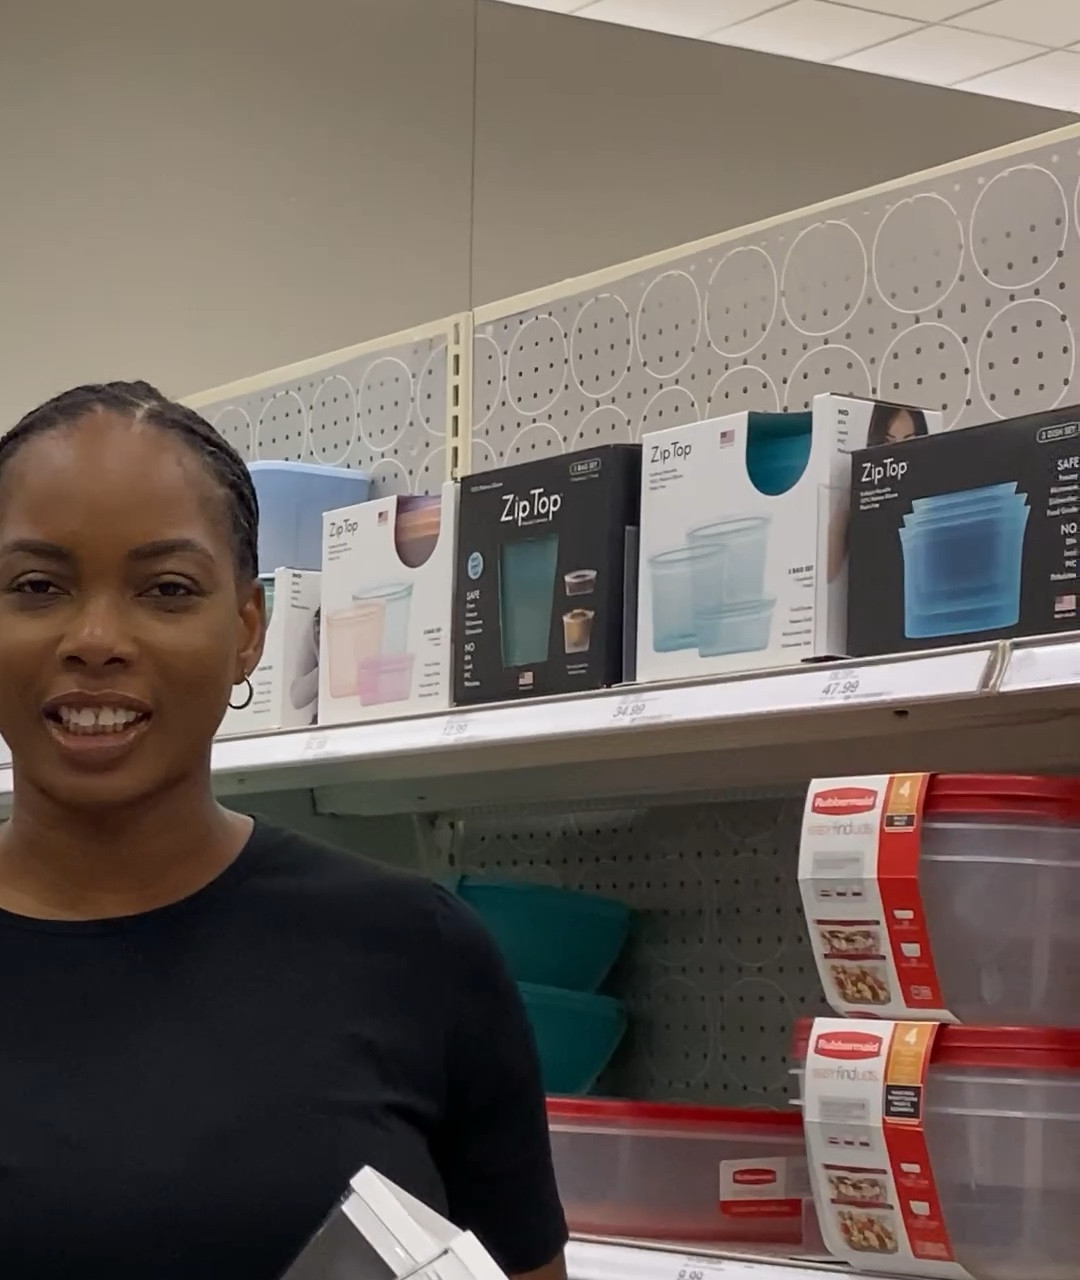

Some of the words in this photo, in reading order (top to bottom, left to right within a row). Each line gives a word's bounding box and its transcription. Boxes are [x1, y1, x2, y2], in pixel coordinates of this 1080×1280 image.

[1057, 456, 1080, 471] SAFE
[1061, 522, 1077, 535] NO
[822, 680, 860, 696] 47.99
[905, 1027, 919, 1046] 4
